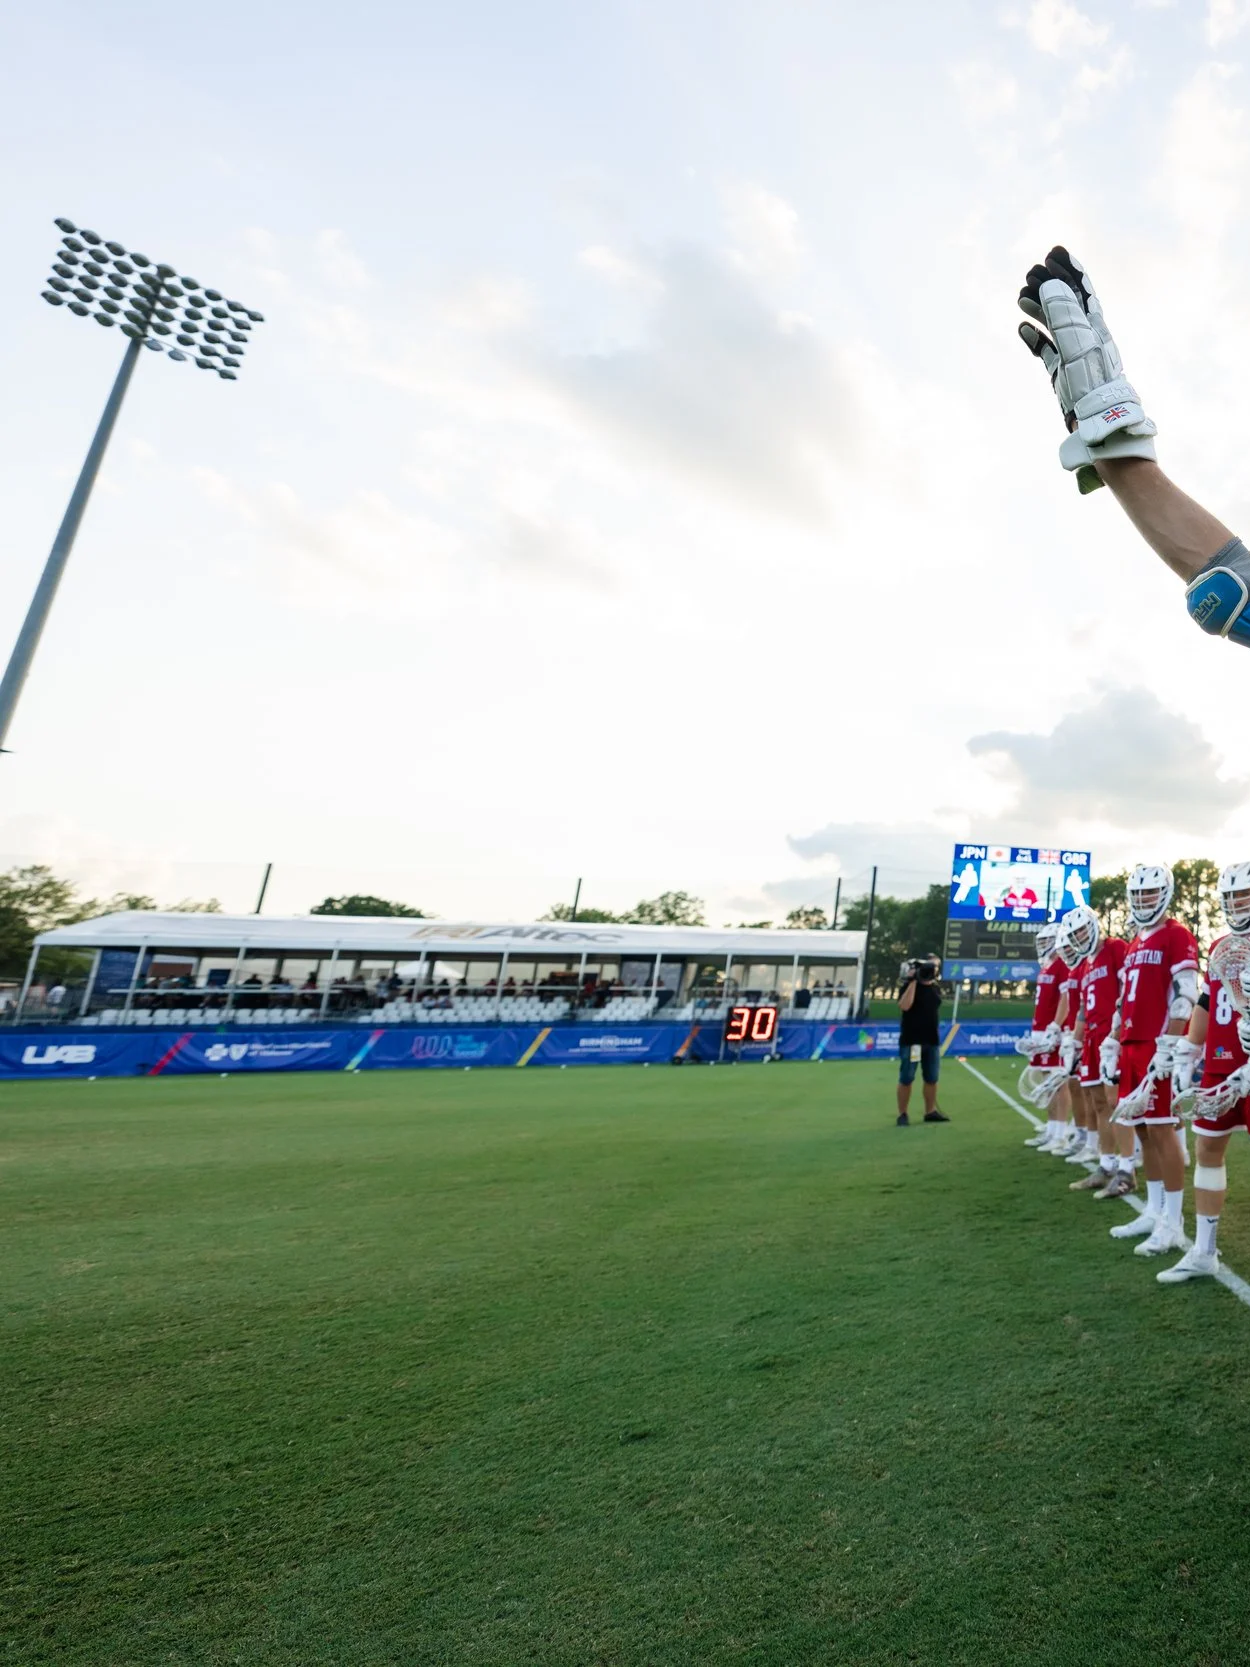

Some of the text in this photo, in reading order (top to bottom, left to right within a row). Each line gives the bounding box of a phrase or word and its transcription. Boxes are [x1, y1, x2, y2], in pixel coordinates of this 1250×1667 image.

[959, 846, 985, 860] JPN
[1061, 852, 1088, 866] GBR
[1215, 986, 1233, 1026] 8
[726, 1008, 776, 1040] 30
